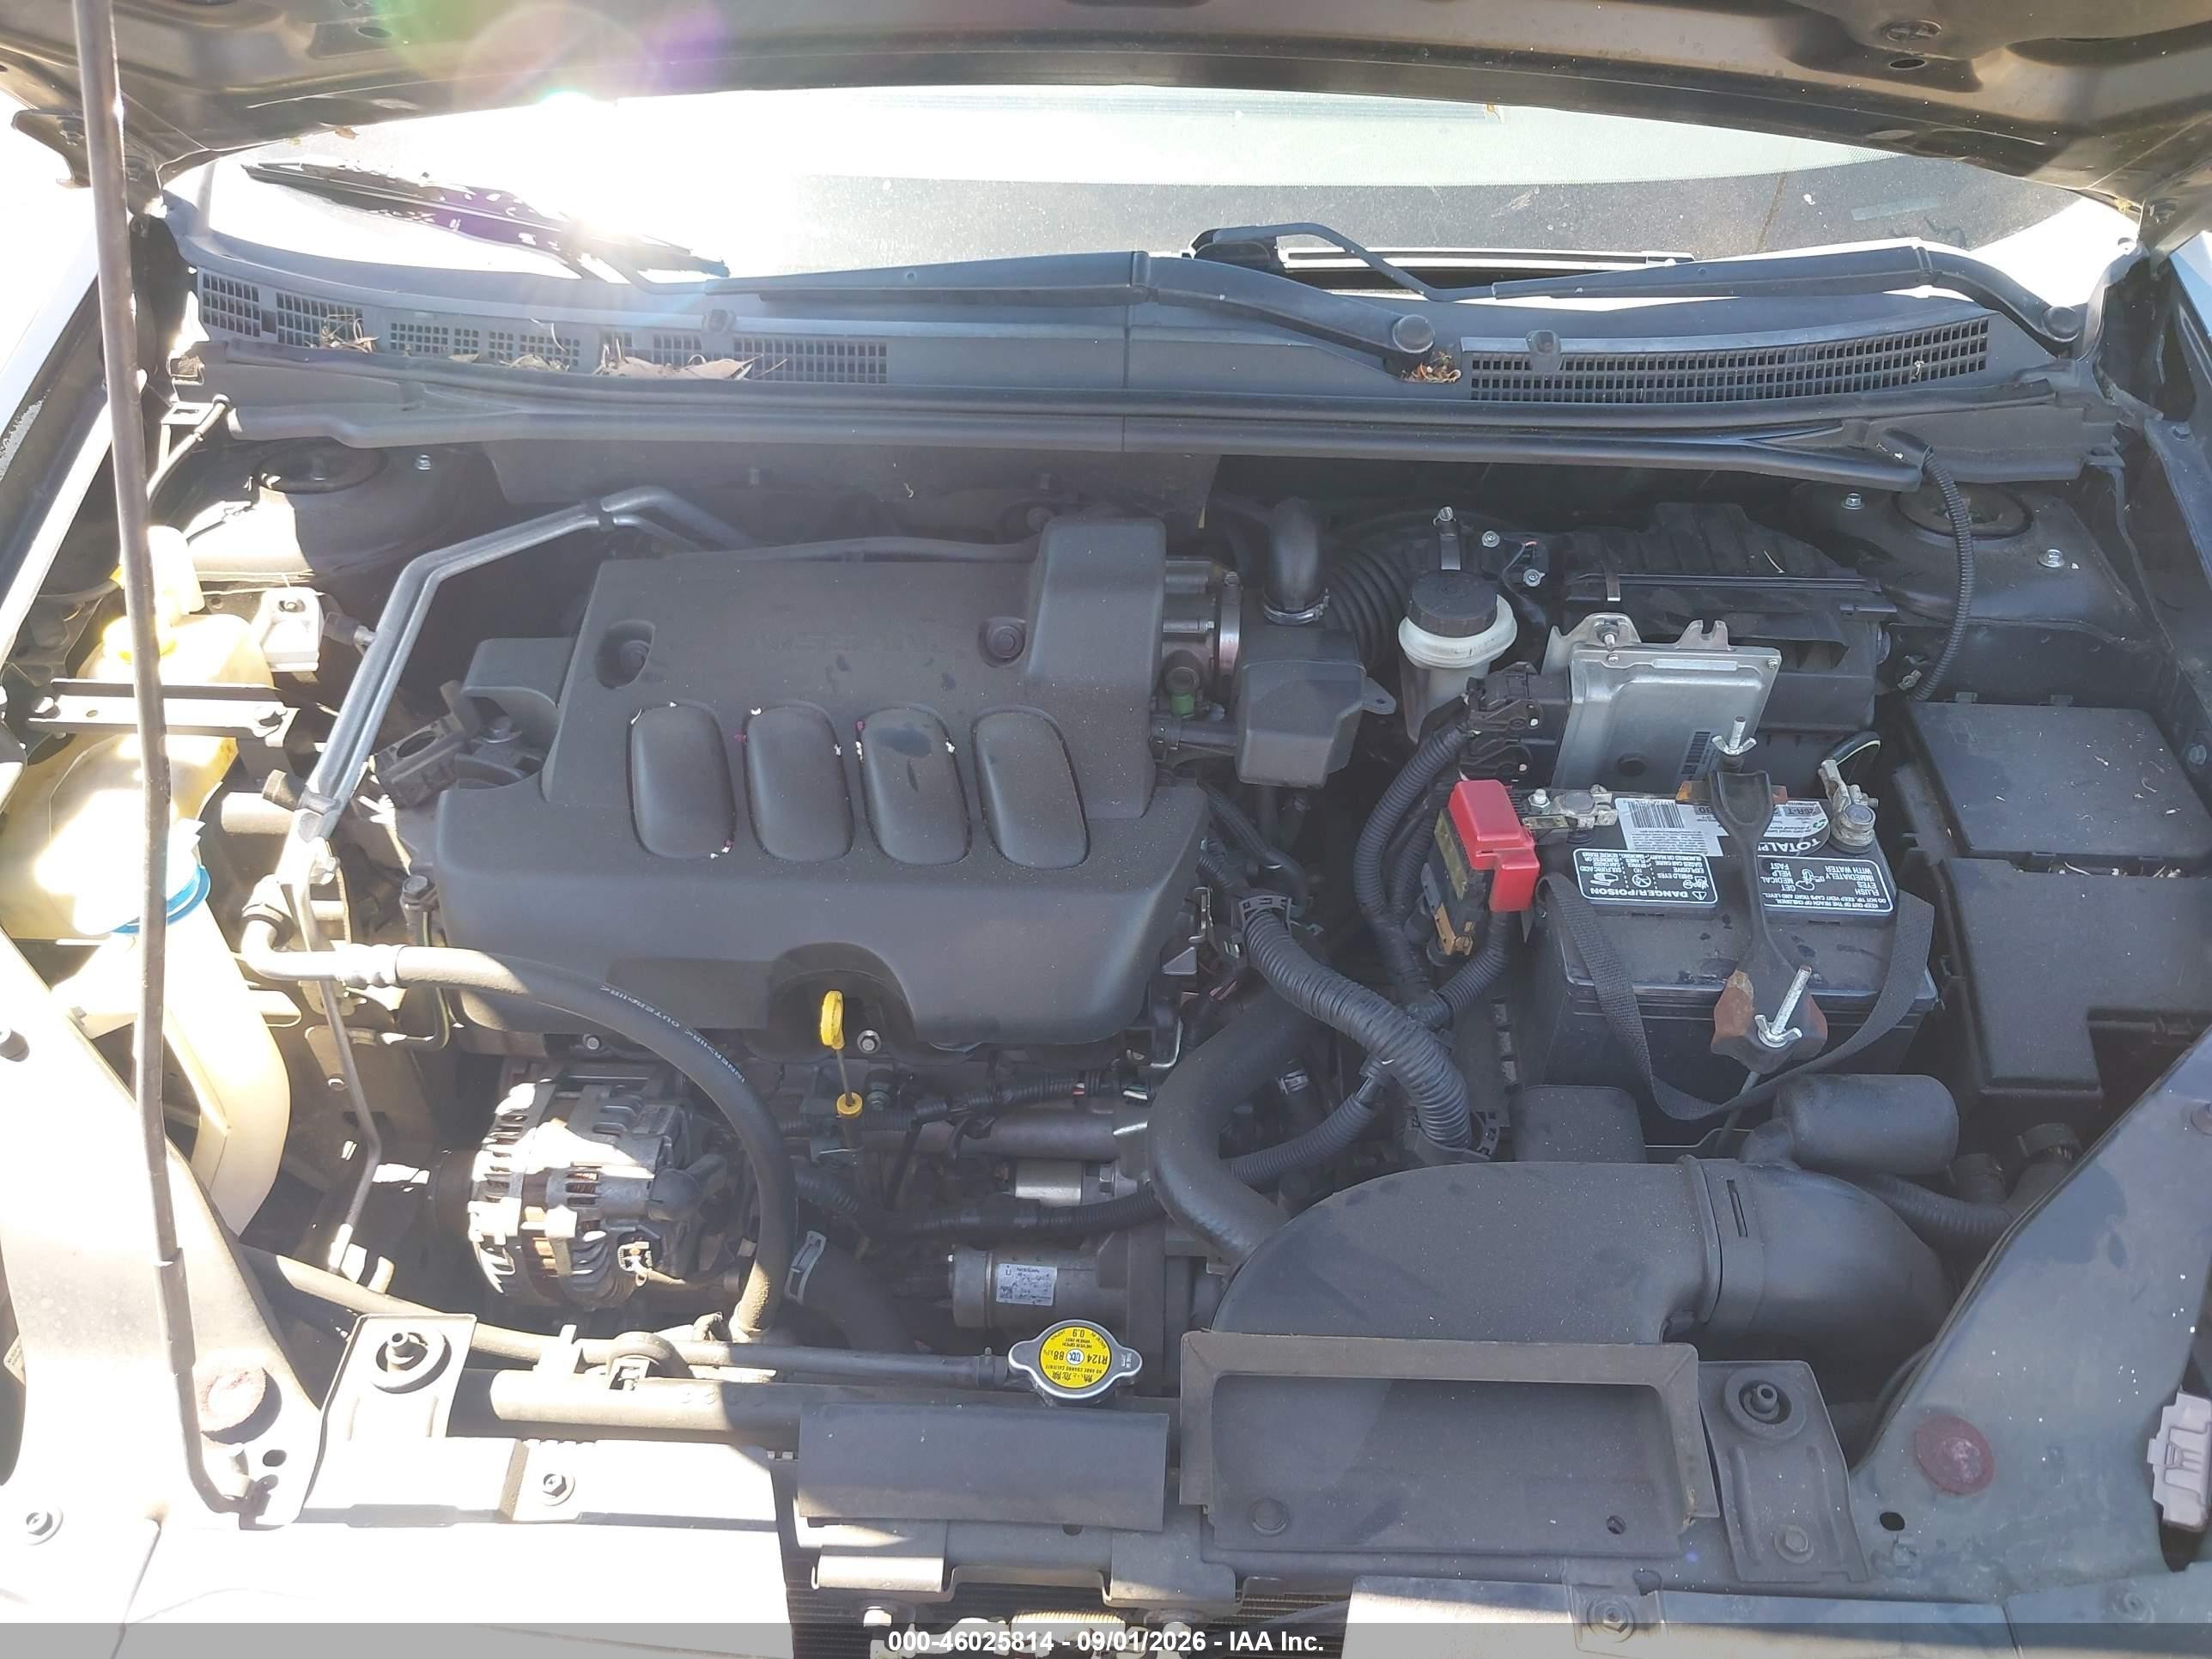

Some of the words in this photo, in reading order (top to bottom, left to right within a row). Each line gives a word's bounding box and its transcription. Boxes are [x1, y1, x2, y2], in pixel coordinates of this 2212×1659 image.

[1825, 872, 1875, 881] IMMEDIATELY
[1589, 888, 1688, 898] DANGER/POISON
[1073, 1329, 1085, 1338] 0.9
[1087, 1353, 1108, 1364] R124
